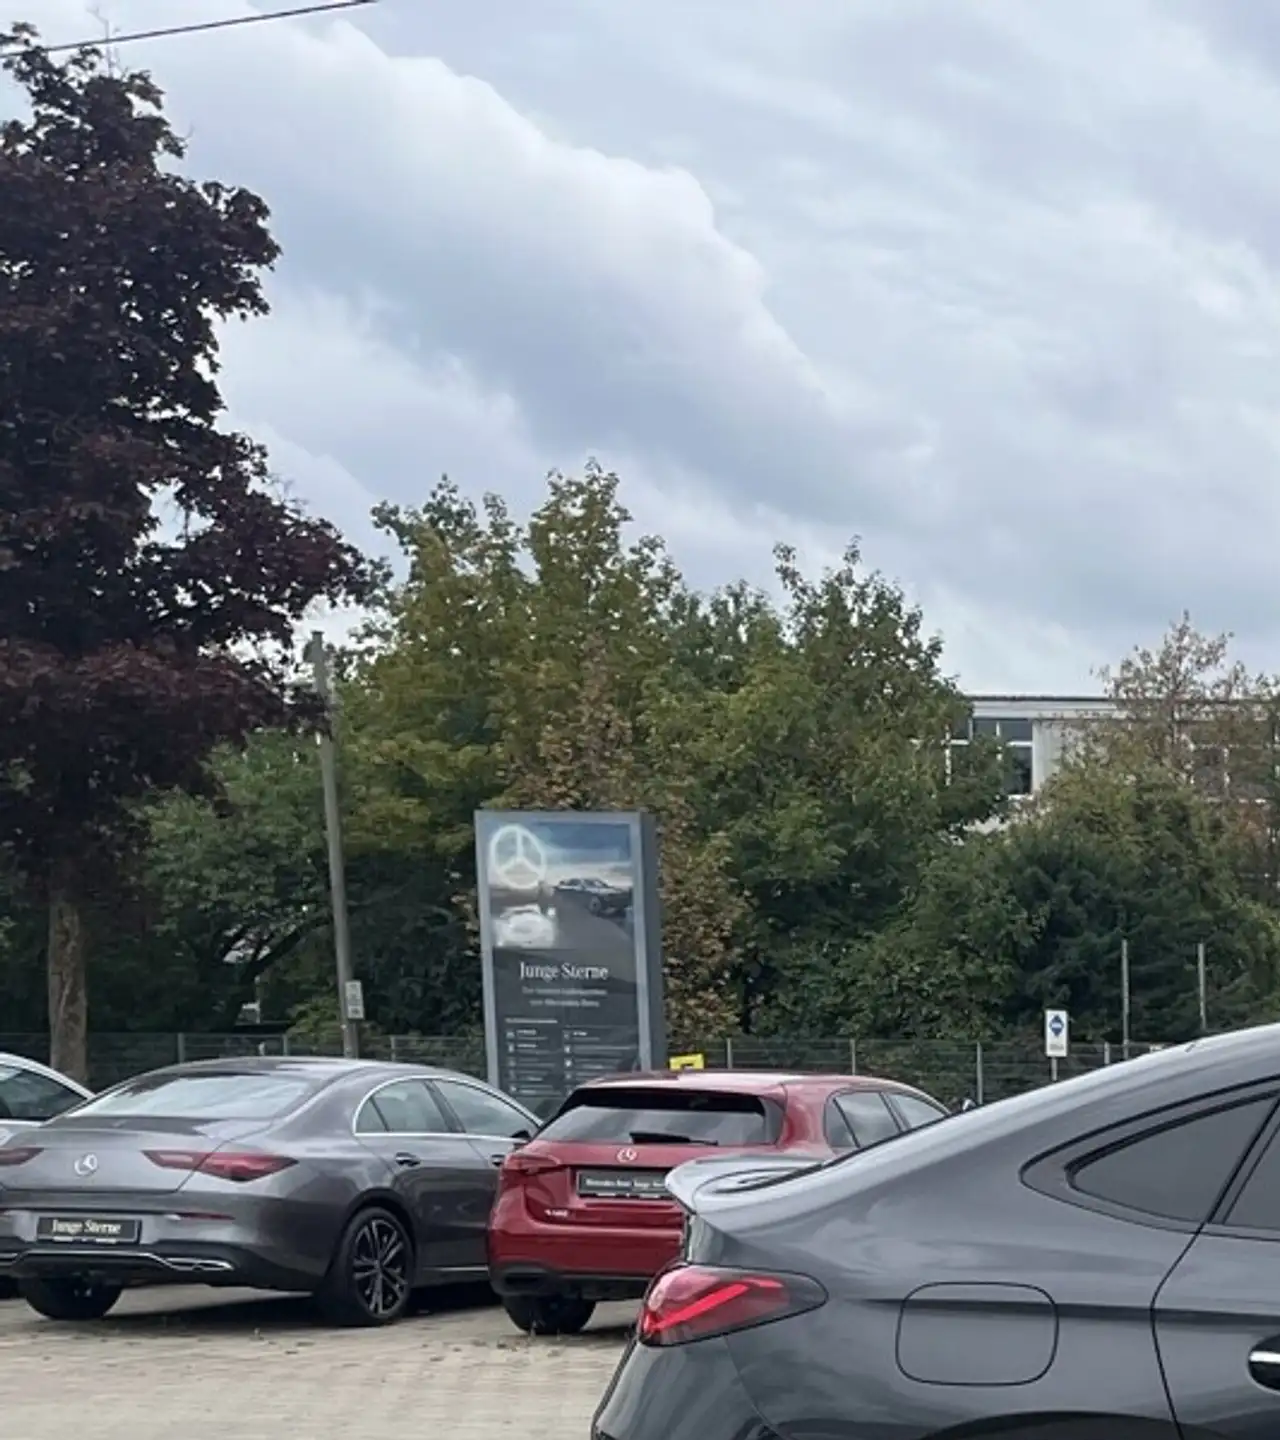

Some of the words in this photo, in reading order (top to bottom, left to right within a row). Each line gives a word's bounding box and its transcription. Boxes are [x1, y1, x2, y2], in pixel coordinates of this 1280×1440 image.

[520, 961, 558, 983] Junge
[560, 962, 609, 980] Sterne
[52, 1219, 82, 1235] Junge
[84, 1219, 121, 1234] Sterne
